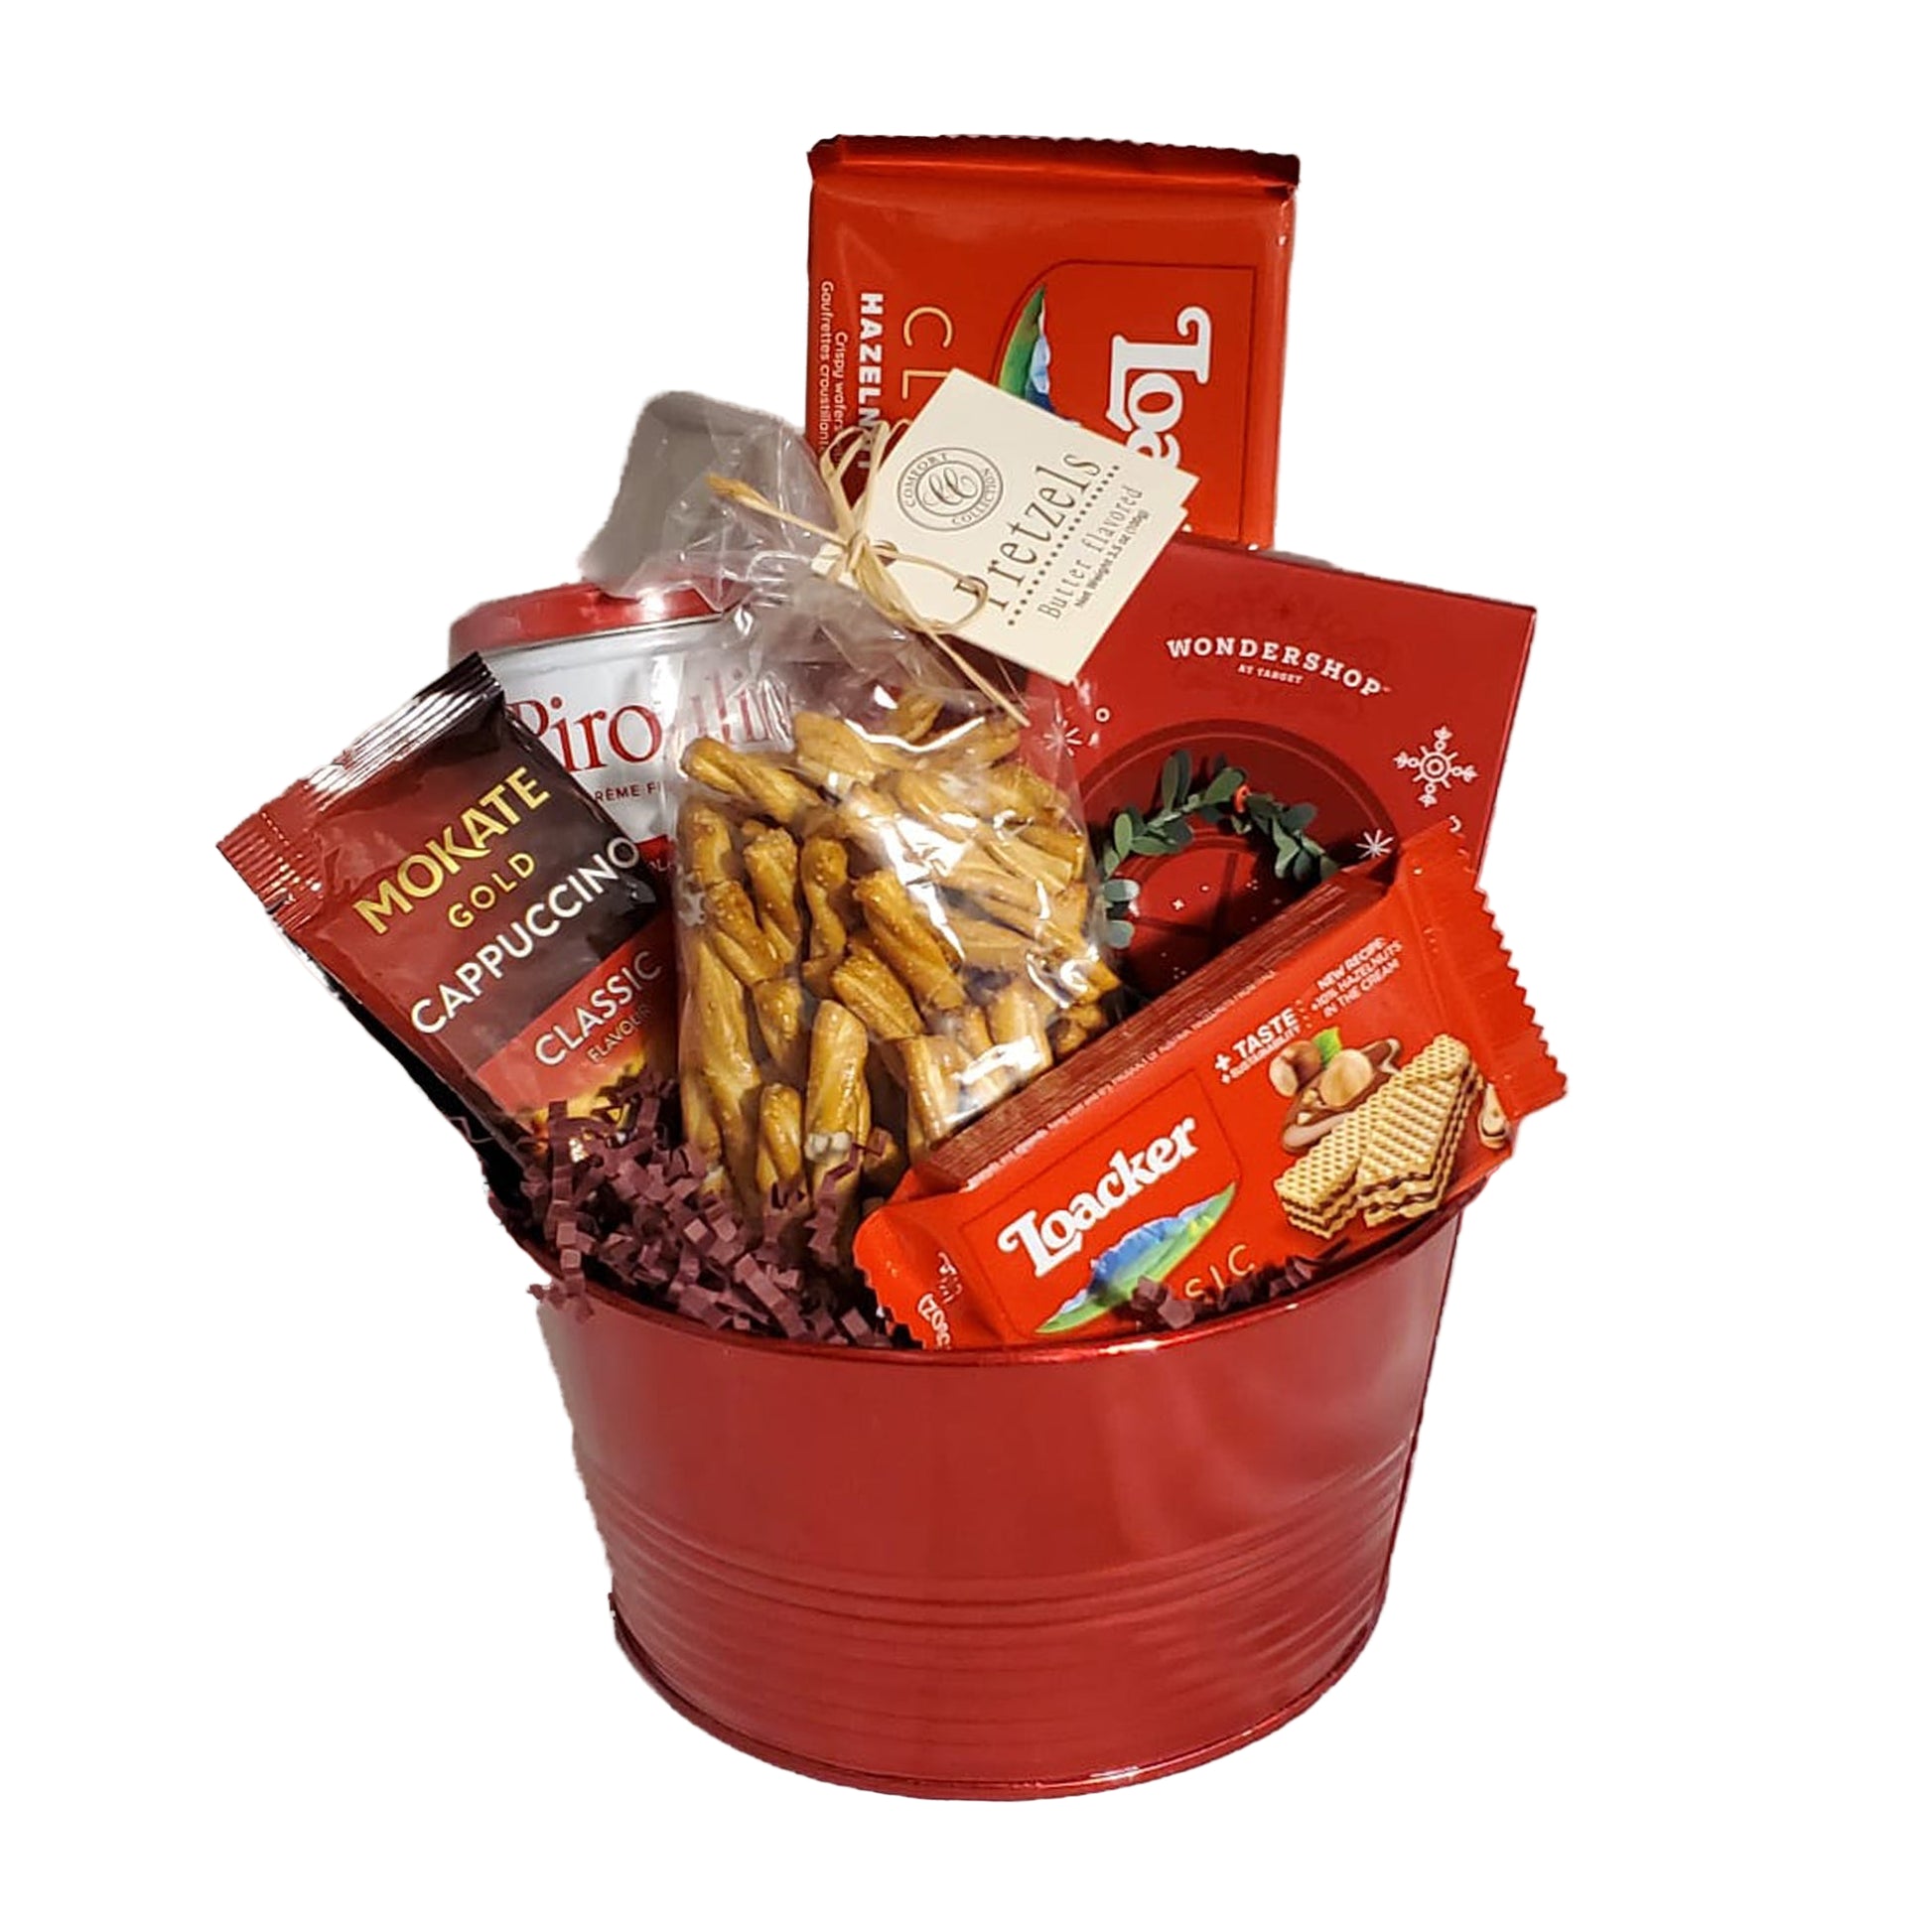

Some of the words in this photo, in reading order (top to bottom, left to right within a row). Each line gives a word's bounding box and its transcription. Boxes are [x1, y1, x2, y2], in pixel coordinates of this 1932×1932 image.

[834, 332, 849, 379] Crispy
[903, 453, 947, 507] COMFORT
[1037, 559, 1091, 619] Butter
[1081, 485, 1143, 552] flavored
[1237, 663, 1254, 675] AT
[1257, 667, 1305, 685] TARGET
[595, 782, 641, 803] RÈME
[351, 765, 551, 935] MOKATE
[447, 851, 537, 930] GOLD
[410, 836, 640, 1035] CAPPUCCINO
[1316, 964, 1346, 992] NEW
[1322, 1004, 1339, 1019] IN
[1338, 986, 1361, 1008] THE
[1359, 958, 1401, 992] CREAM
[1336, 940, 1403, 993] HAZELNUTS
[534, 949, 664, 1067] CLASSIC
[1232, 1007, 1300, 1058] TASTE
[997, 1117, 1199, 1279] Loacker
